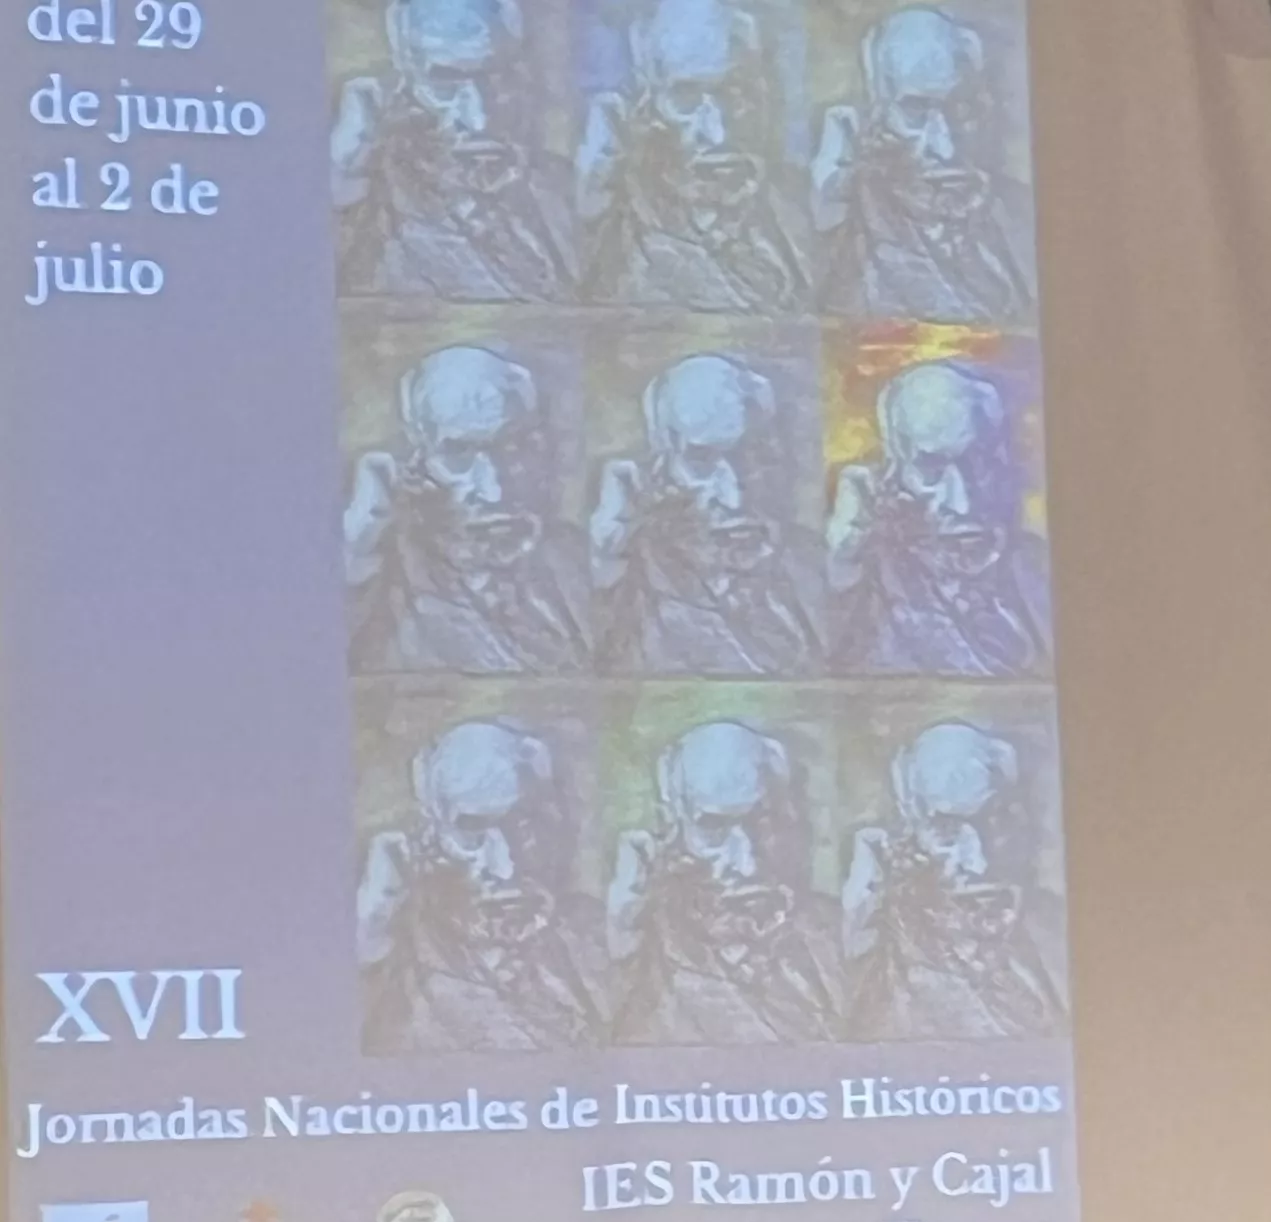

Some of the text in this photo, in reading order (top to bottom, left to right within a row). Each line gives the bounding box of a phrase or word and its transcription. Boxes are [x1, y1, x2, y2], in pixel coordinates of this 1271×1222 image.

[28, 0, 202, 49] del 29
[30, 73, 266, 143] de junio
[32, 157, 220, 215] al 2 de
[25, 240, 164, 305] julio
[36, 968, 246, 1042] XVII
[17, 1073, 1062, 1158] Jornadas Nacionales de Institutos Históricos
[583, 1147, 1055, 1211] IES Ramón y Cajal
